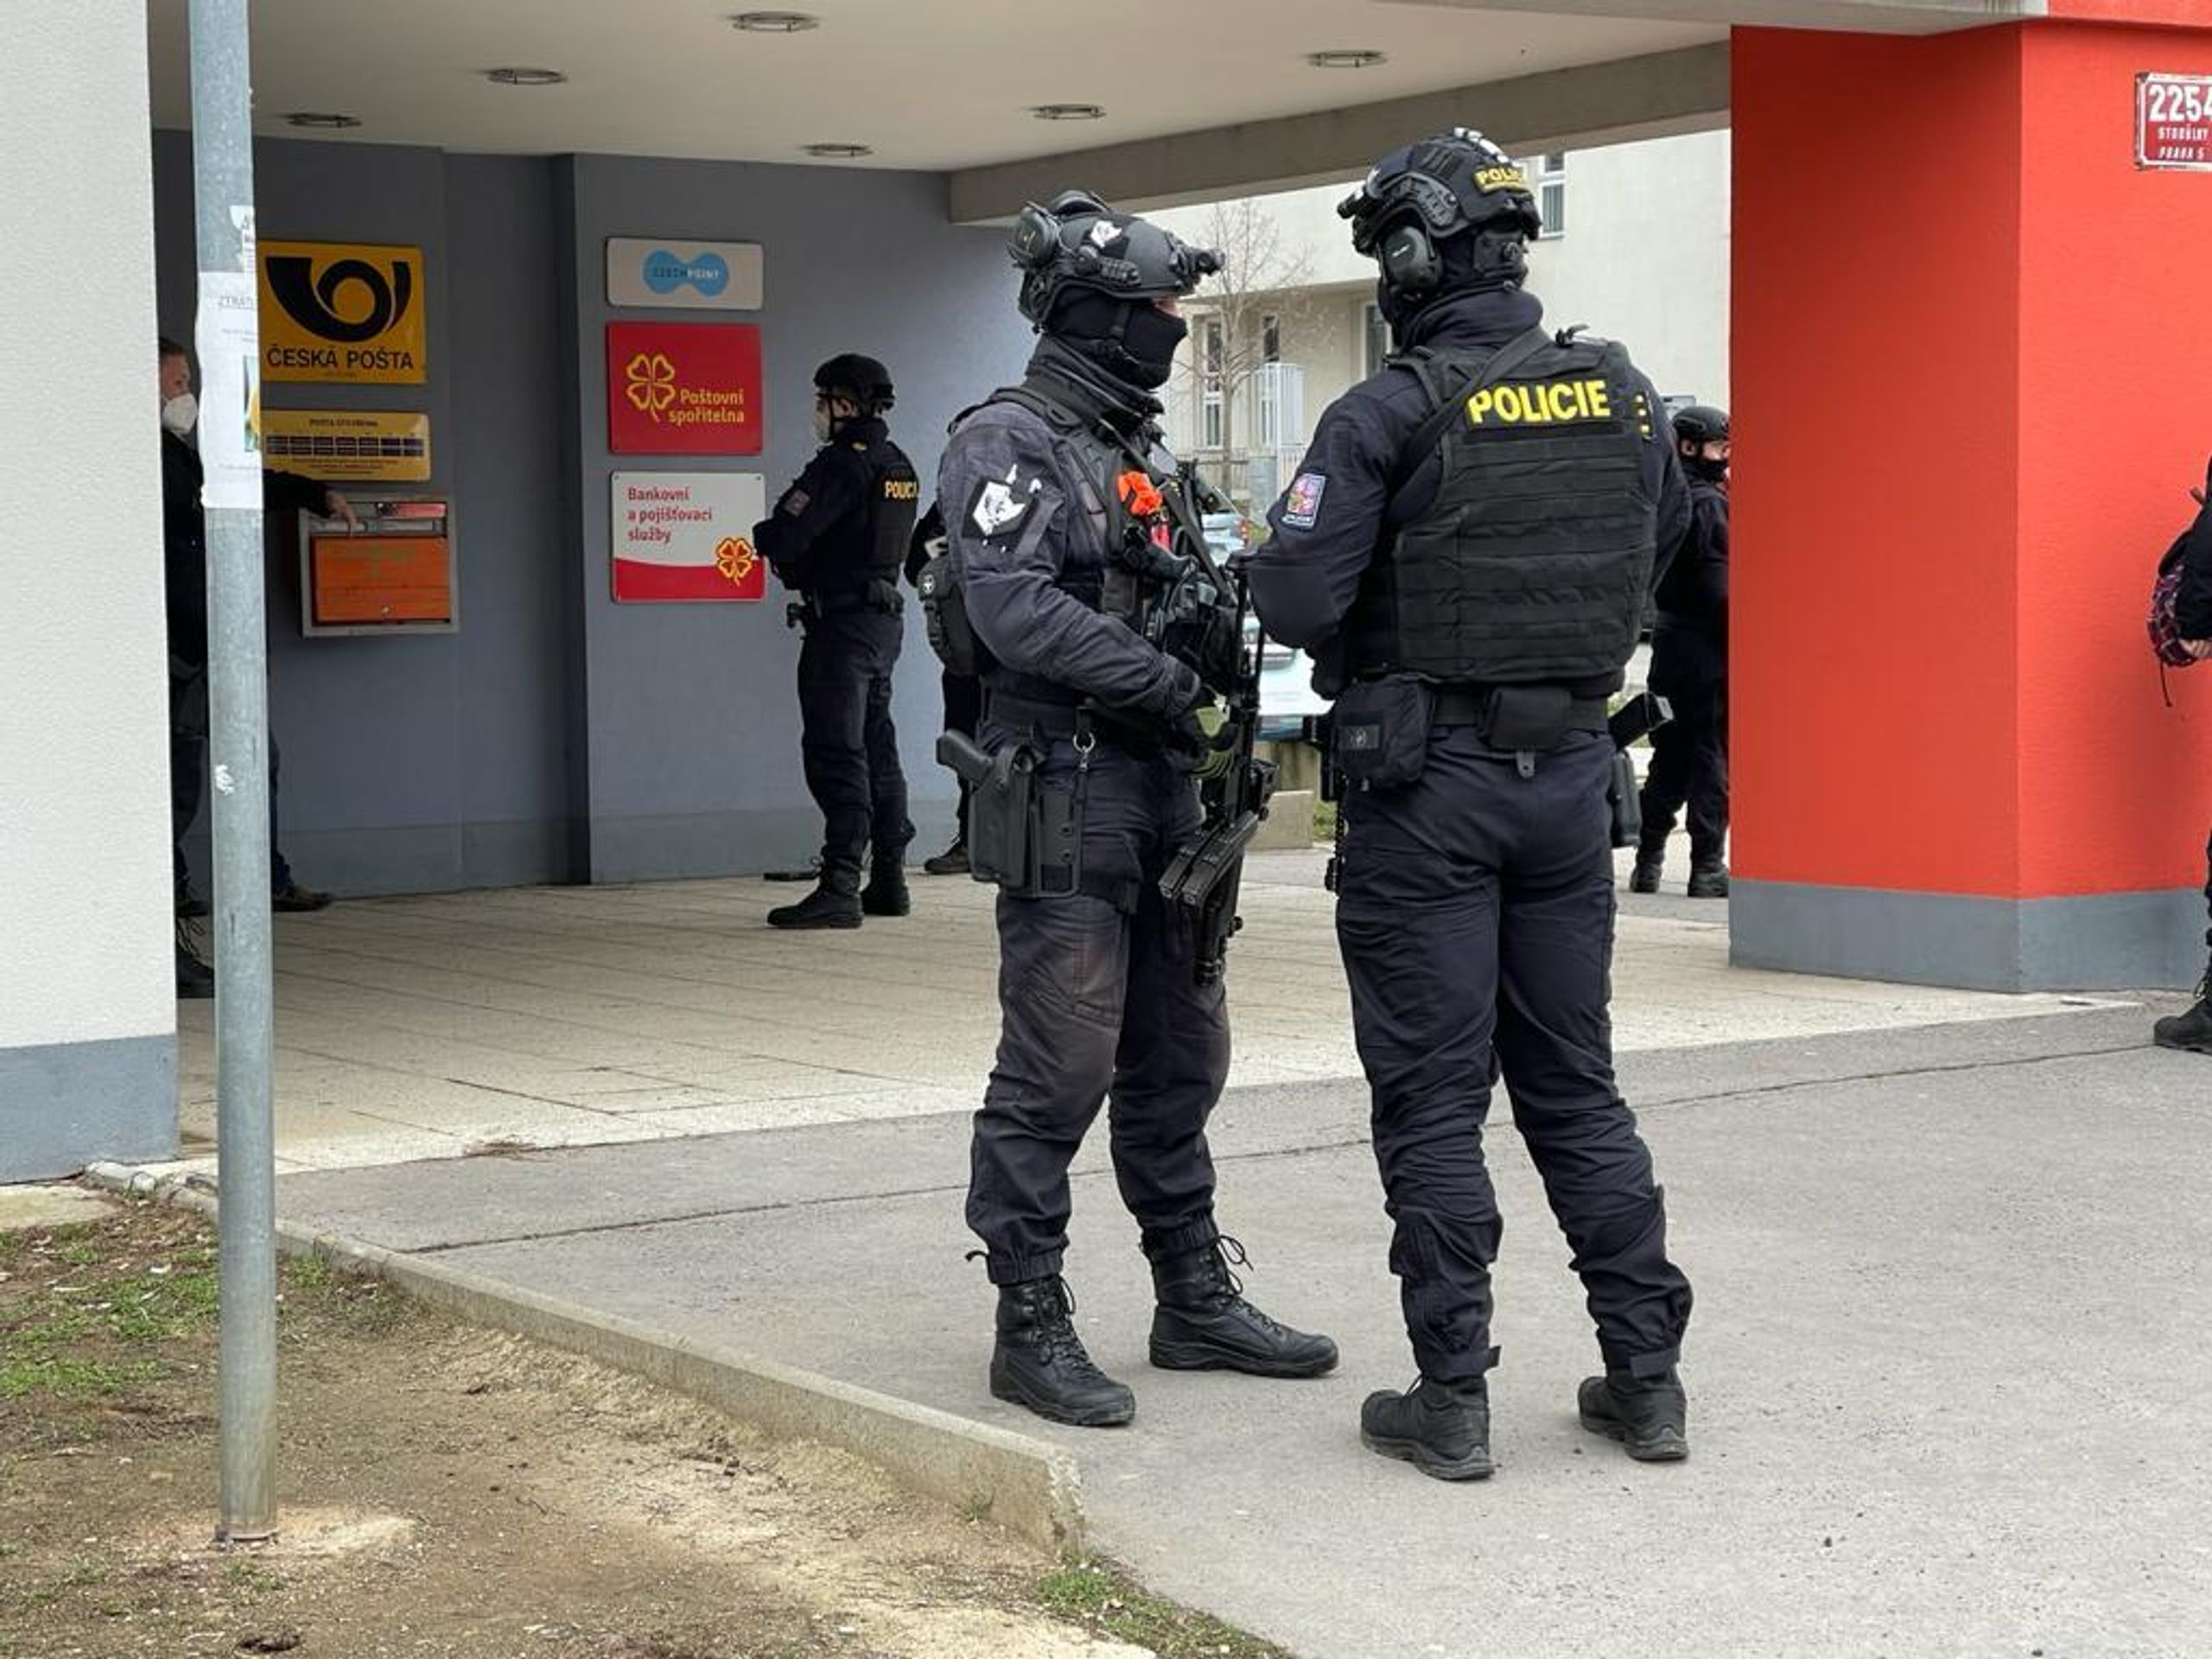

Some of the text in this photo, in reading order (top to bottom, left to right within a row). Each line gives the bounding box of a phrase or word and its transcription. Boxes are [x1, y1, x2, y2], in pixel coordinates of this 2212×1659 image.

[267, 344, 414, 370] ČESKÁ POŠTA
[680, 387, 745, 405] Poštovní
[1468, 379, 1611, 424] POLICIE
[668, 406, 745, 427] spořitelna
[627, 486, 690, 500] Bankovní
[628, 505, 712, 524] a pojišťovací
[627, 526, 671, 544] služby
